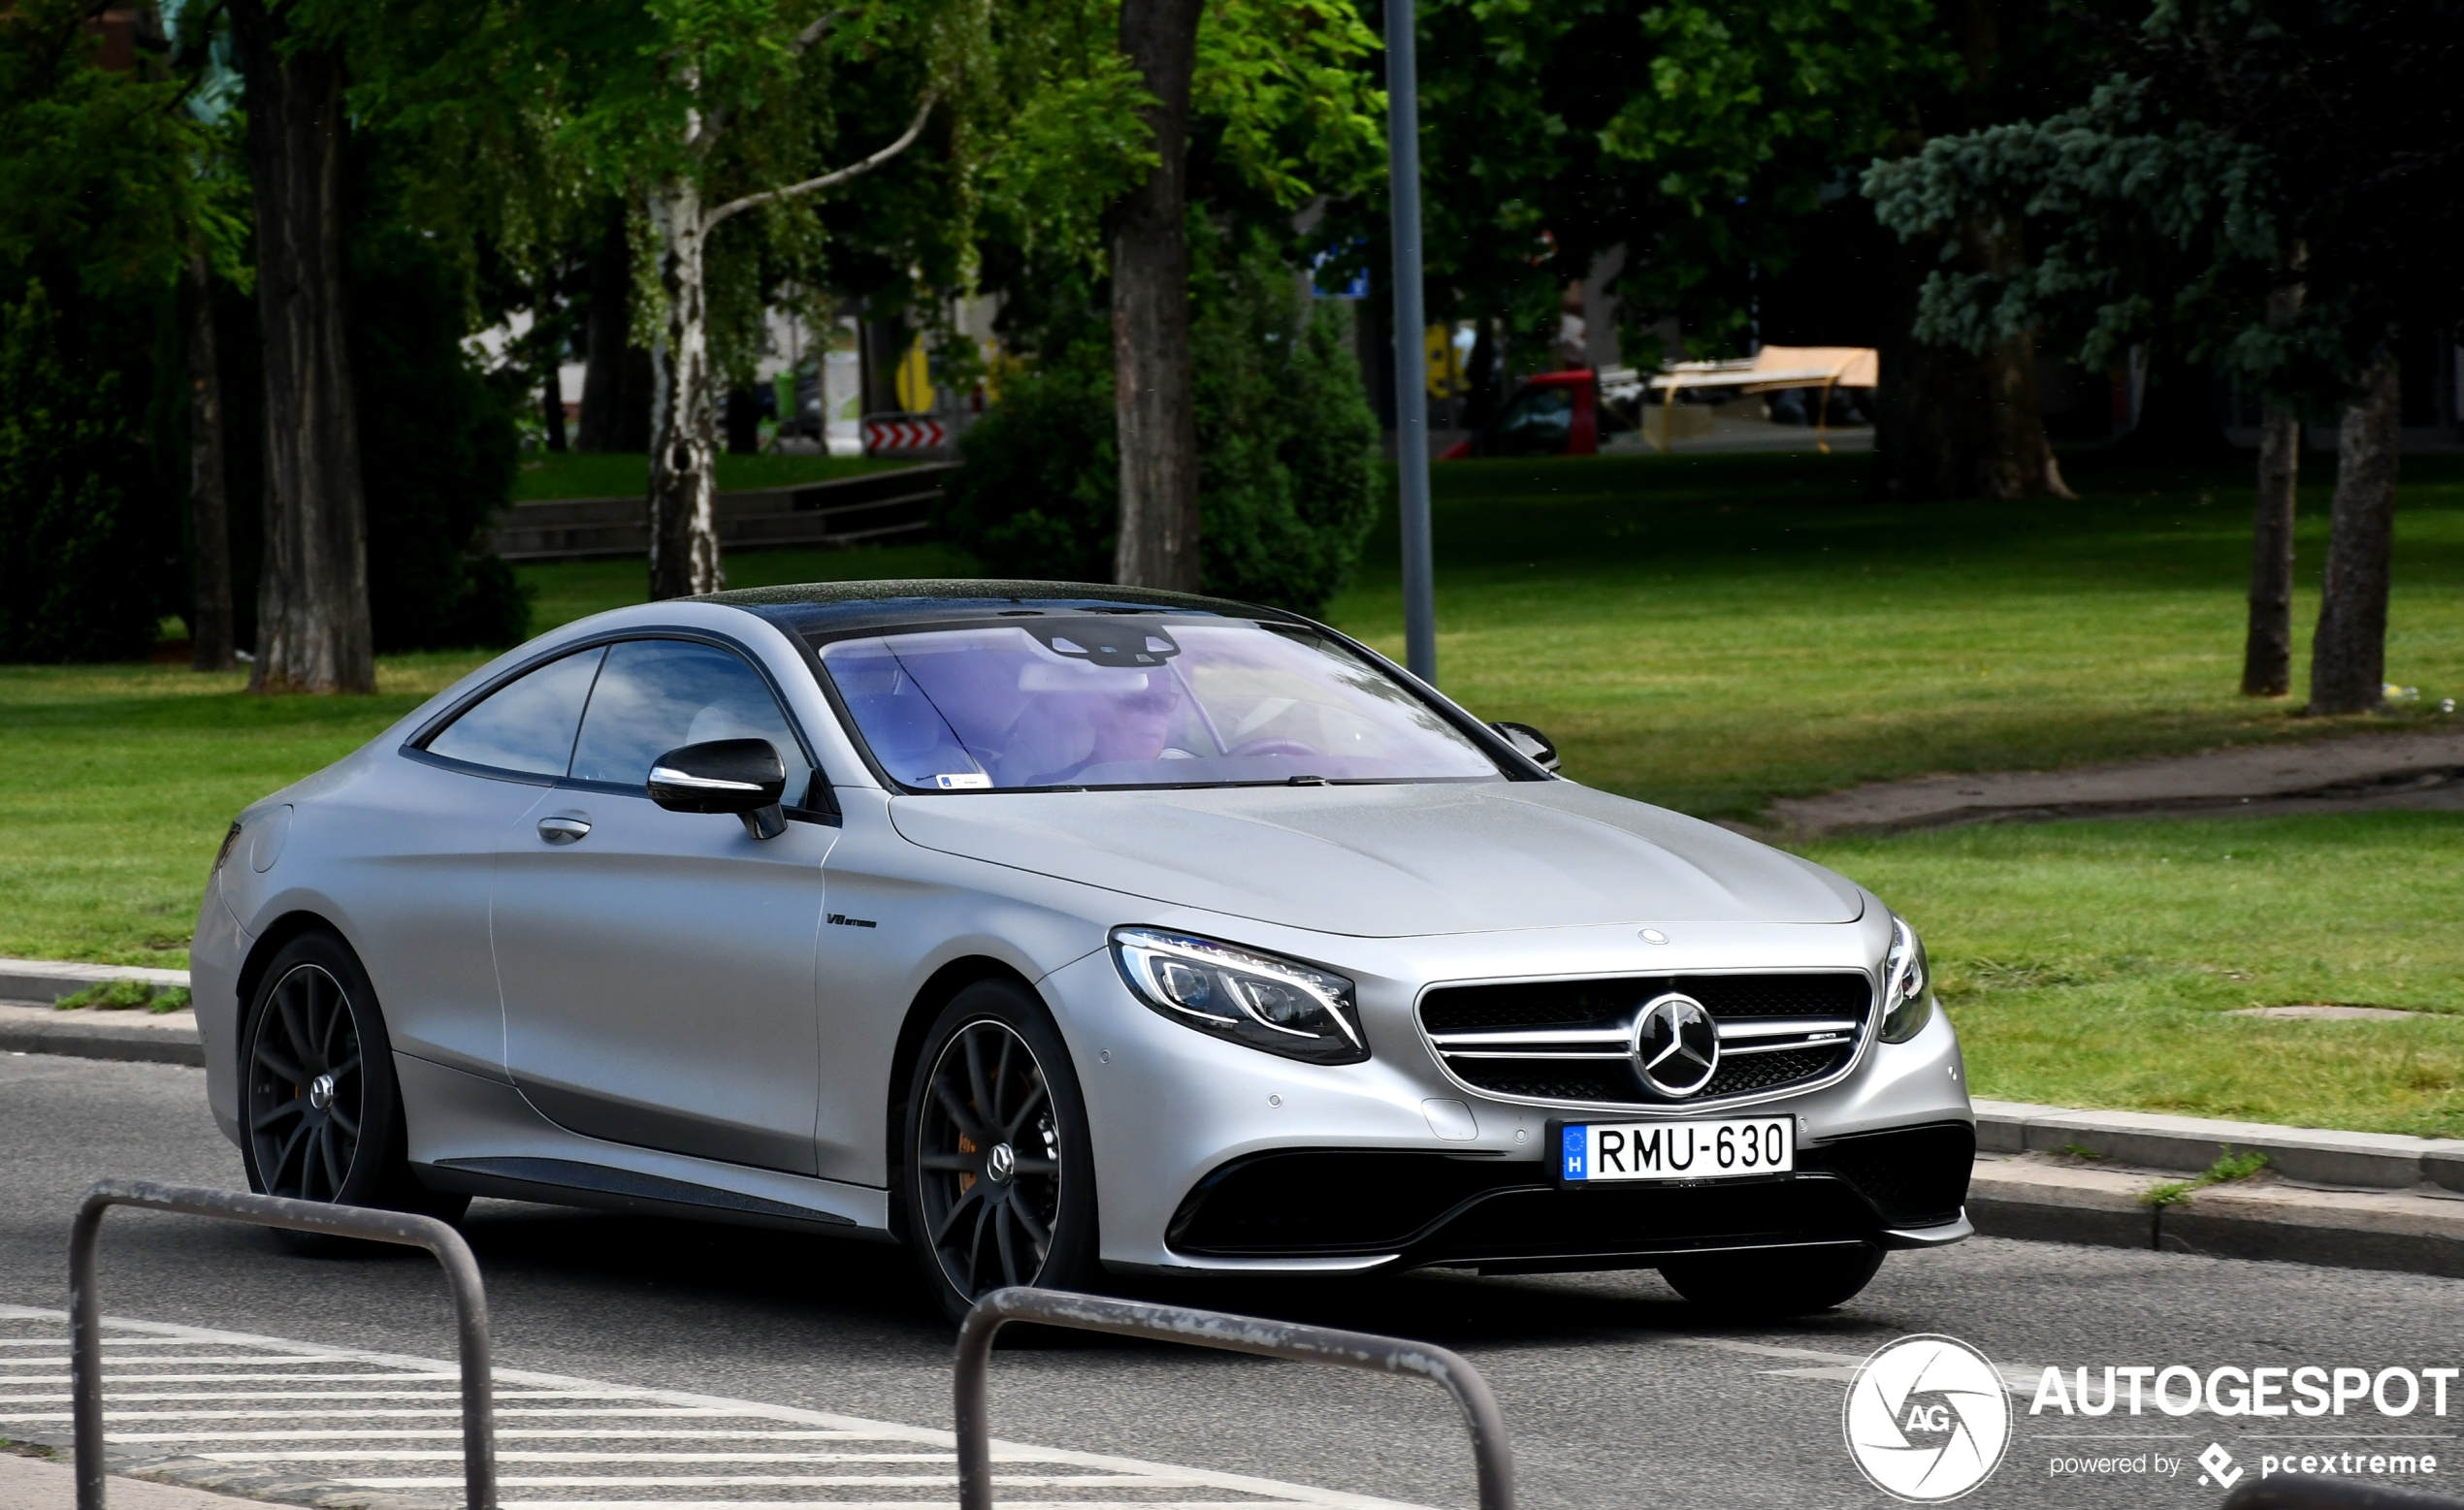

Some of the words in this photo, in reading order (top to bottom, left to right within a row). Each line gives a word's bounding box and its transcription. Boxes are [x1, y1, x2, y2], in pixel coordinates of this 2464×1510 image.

[827, 914, 845, 924] V8
[1599, 1123, 1783, 1173] RMU-630
[1568, 1156, 1581, 1173] H
